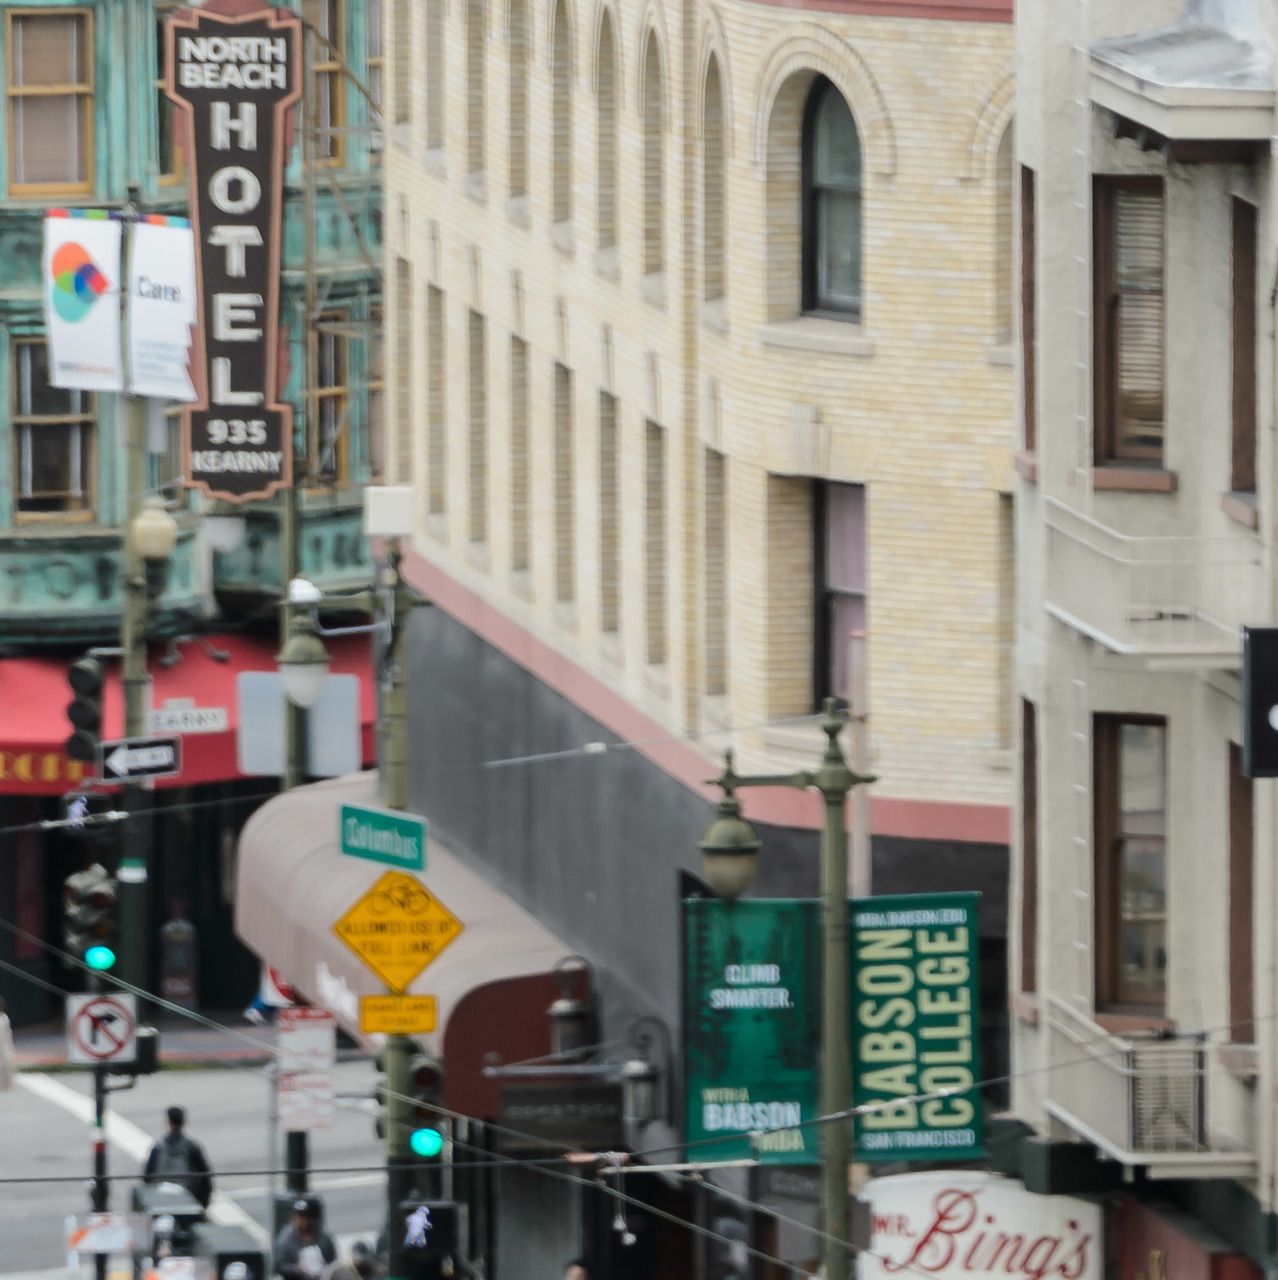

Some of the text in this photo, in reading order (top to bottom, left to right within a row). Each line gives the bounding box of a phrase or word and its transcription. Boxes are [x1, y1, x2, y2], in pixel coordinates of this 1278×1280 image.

[179, 37, 287, 62] NORTH
[179, 63, 287, 89] BEACH
[207, 101, 264, 406] HOTEL
[207, 419, 267, 444] 935
[192, 450, 282, 473] KEARNY
[345, 817, 419, 860] Columbus
[725, 963, 780, 984] CLIMB
[857, 928, 918, 1130] BABSON
[916, 926, 974, 1128] COLLEGE
[703, 1101, 801, 1131] BABSON
[861, 1129, 975, 1150] SAN FRANCISCO
